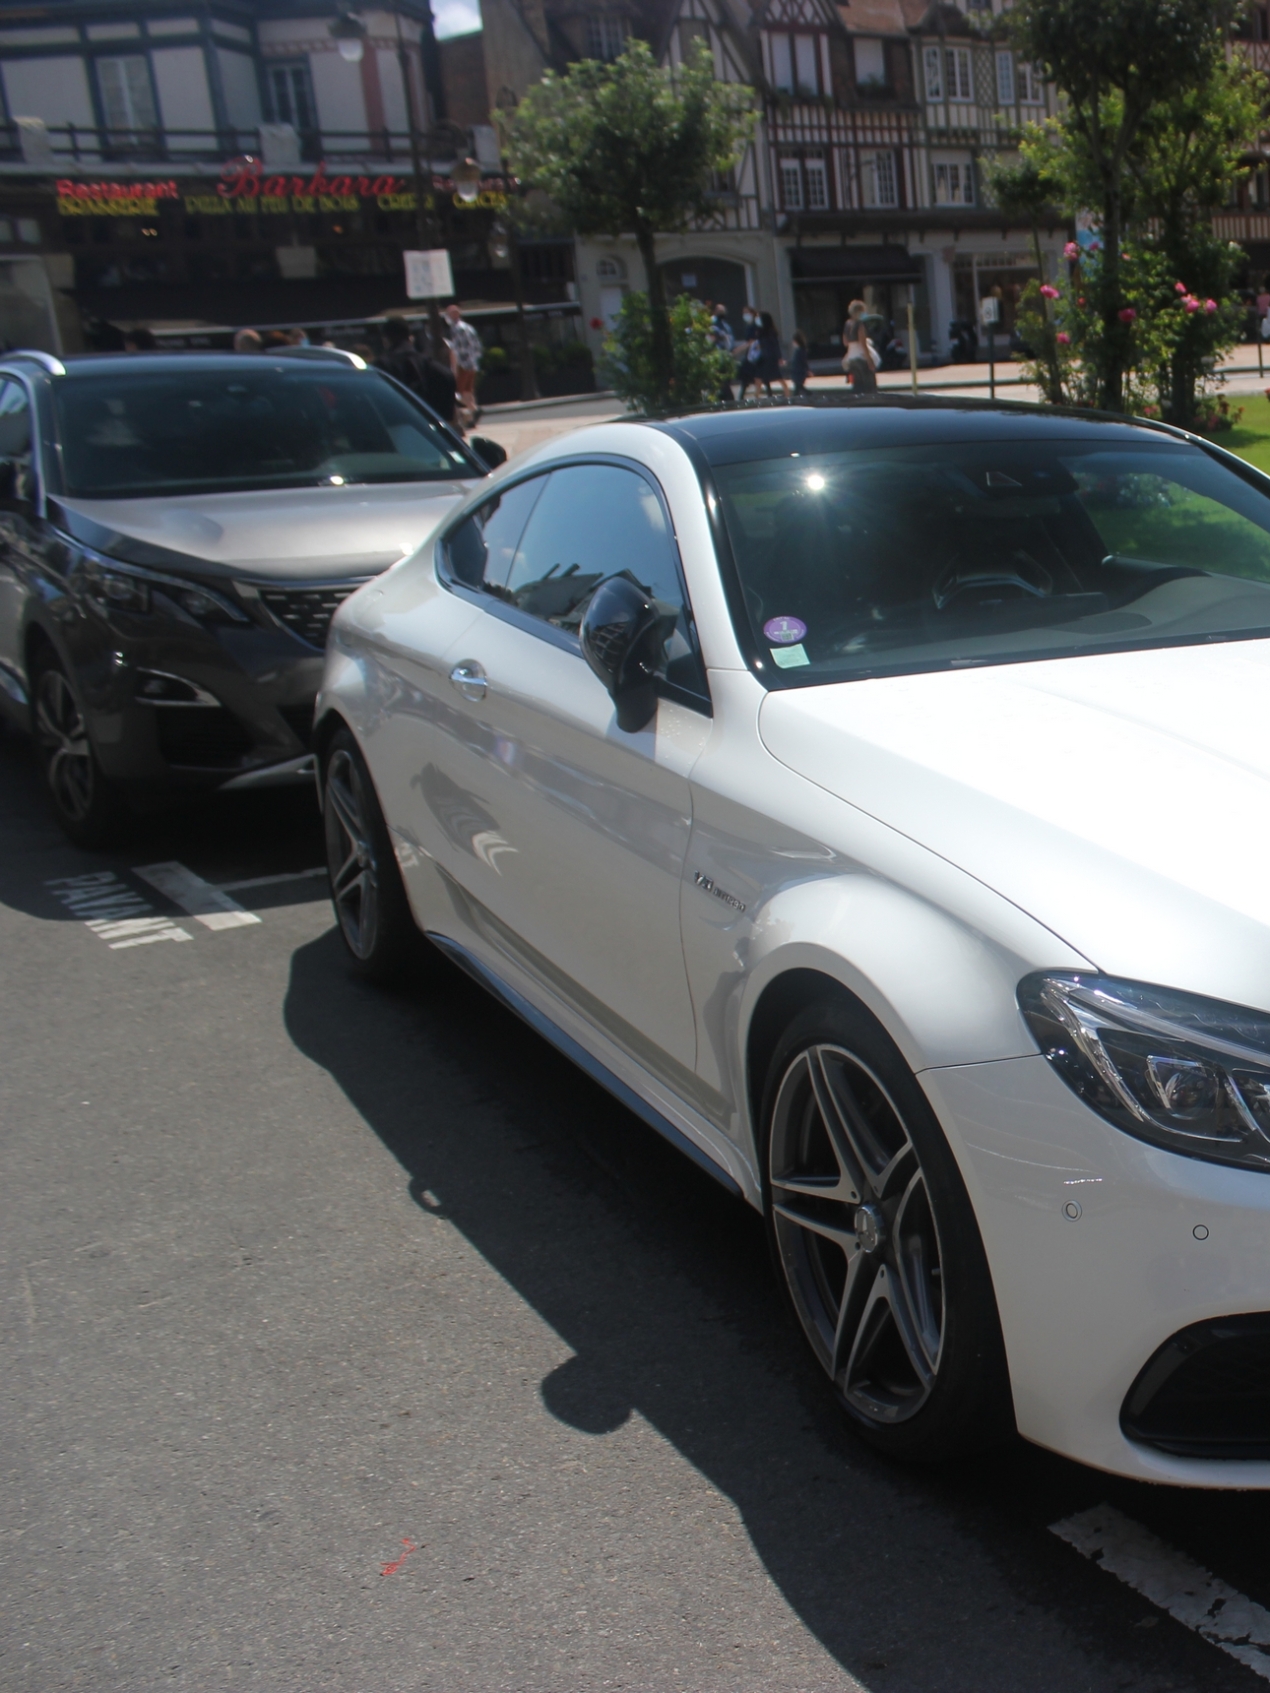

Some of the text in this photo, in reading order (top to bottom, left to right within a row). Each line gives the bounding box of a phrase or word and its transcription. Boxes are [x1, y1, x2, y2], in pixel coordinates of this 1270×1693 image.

[56, 179, 178, 199] Restaurant
[216, 155, 405, 198] Barbara
[293, 196, 316, 213] DE
[43, 871, 195, 950] PAYANT
